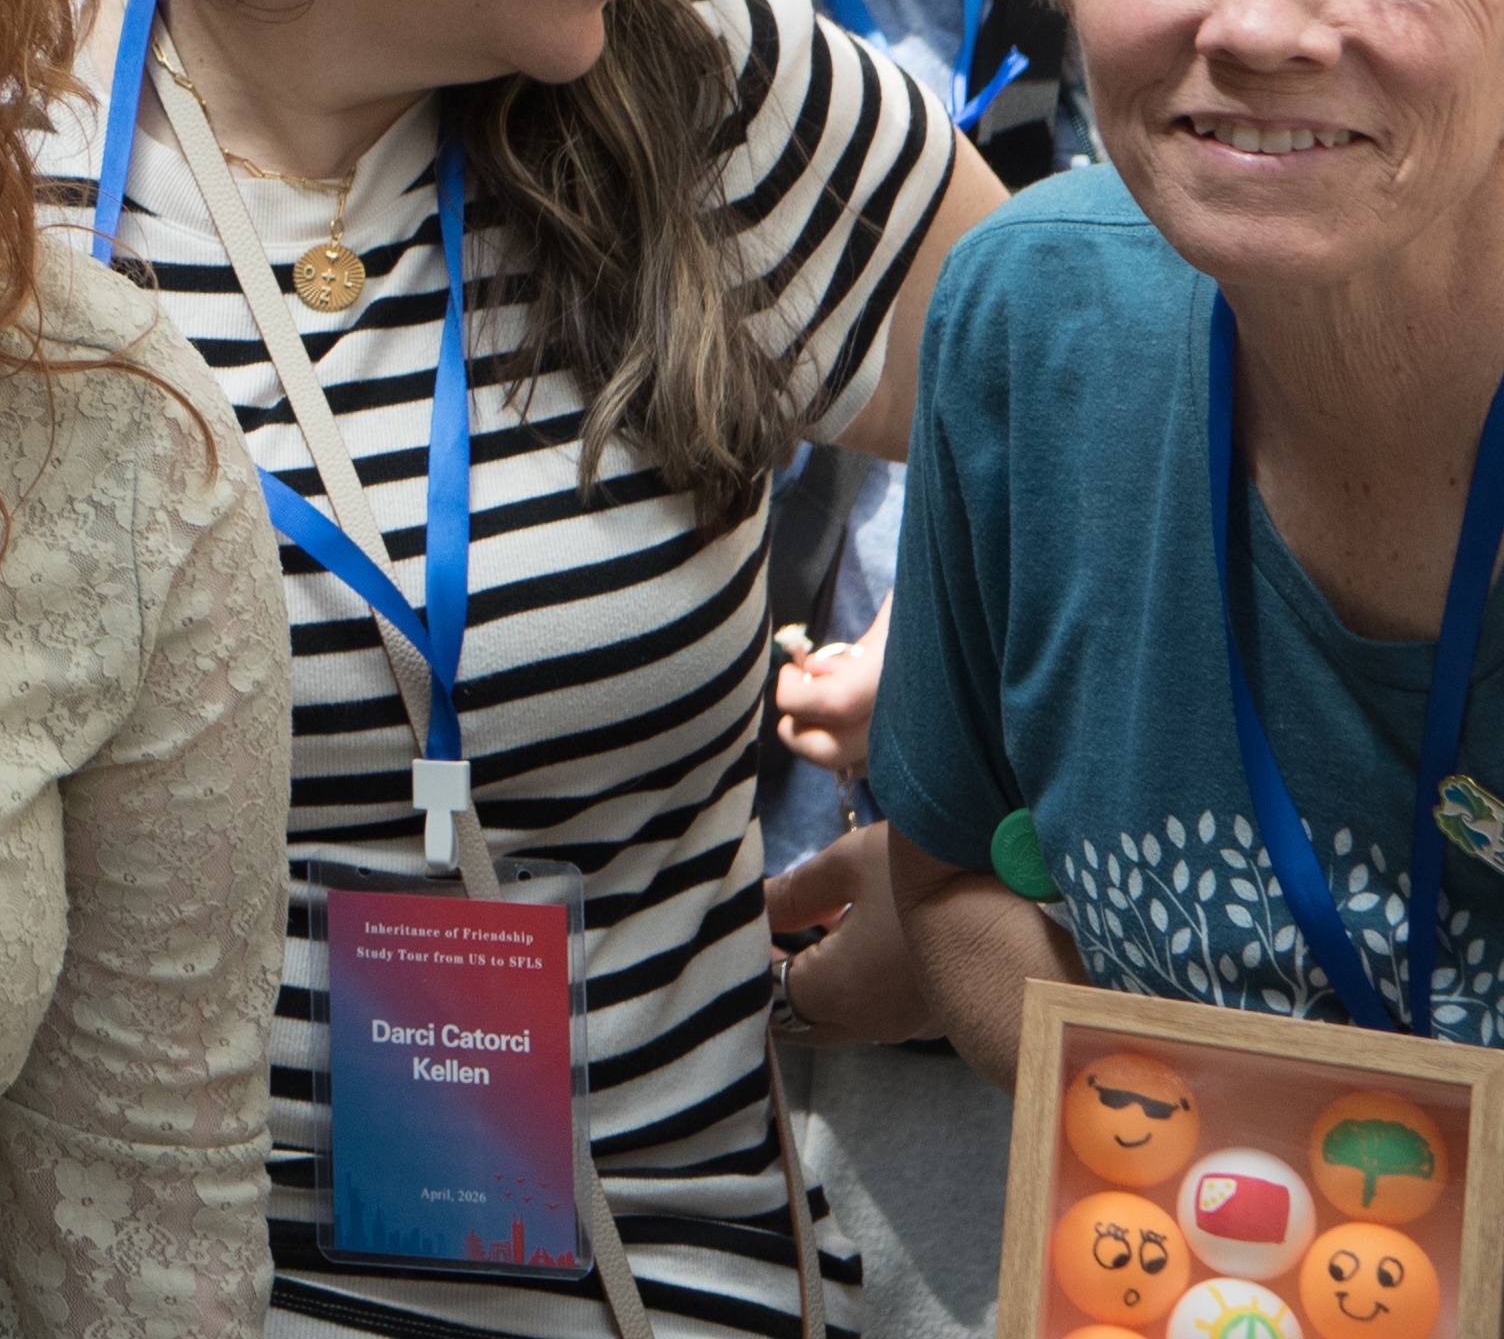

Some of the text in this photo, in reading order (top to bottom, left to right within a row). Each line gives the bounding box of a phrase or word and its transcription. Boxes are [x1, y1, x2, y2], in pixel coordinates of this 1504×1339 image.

[365, 922, 534, 946] Inheritance of Friendship
[356, 946, 543, 970] Study Tour from US to SFLS
[372, 1019, 530, 1053] Darci Catorci
[412, 1056, 490, 1085] Kellen
[421, 1185, 487, 1204] April, 2026
